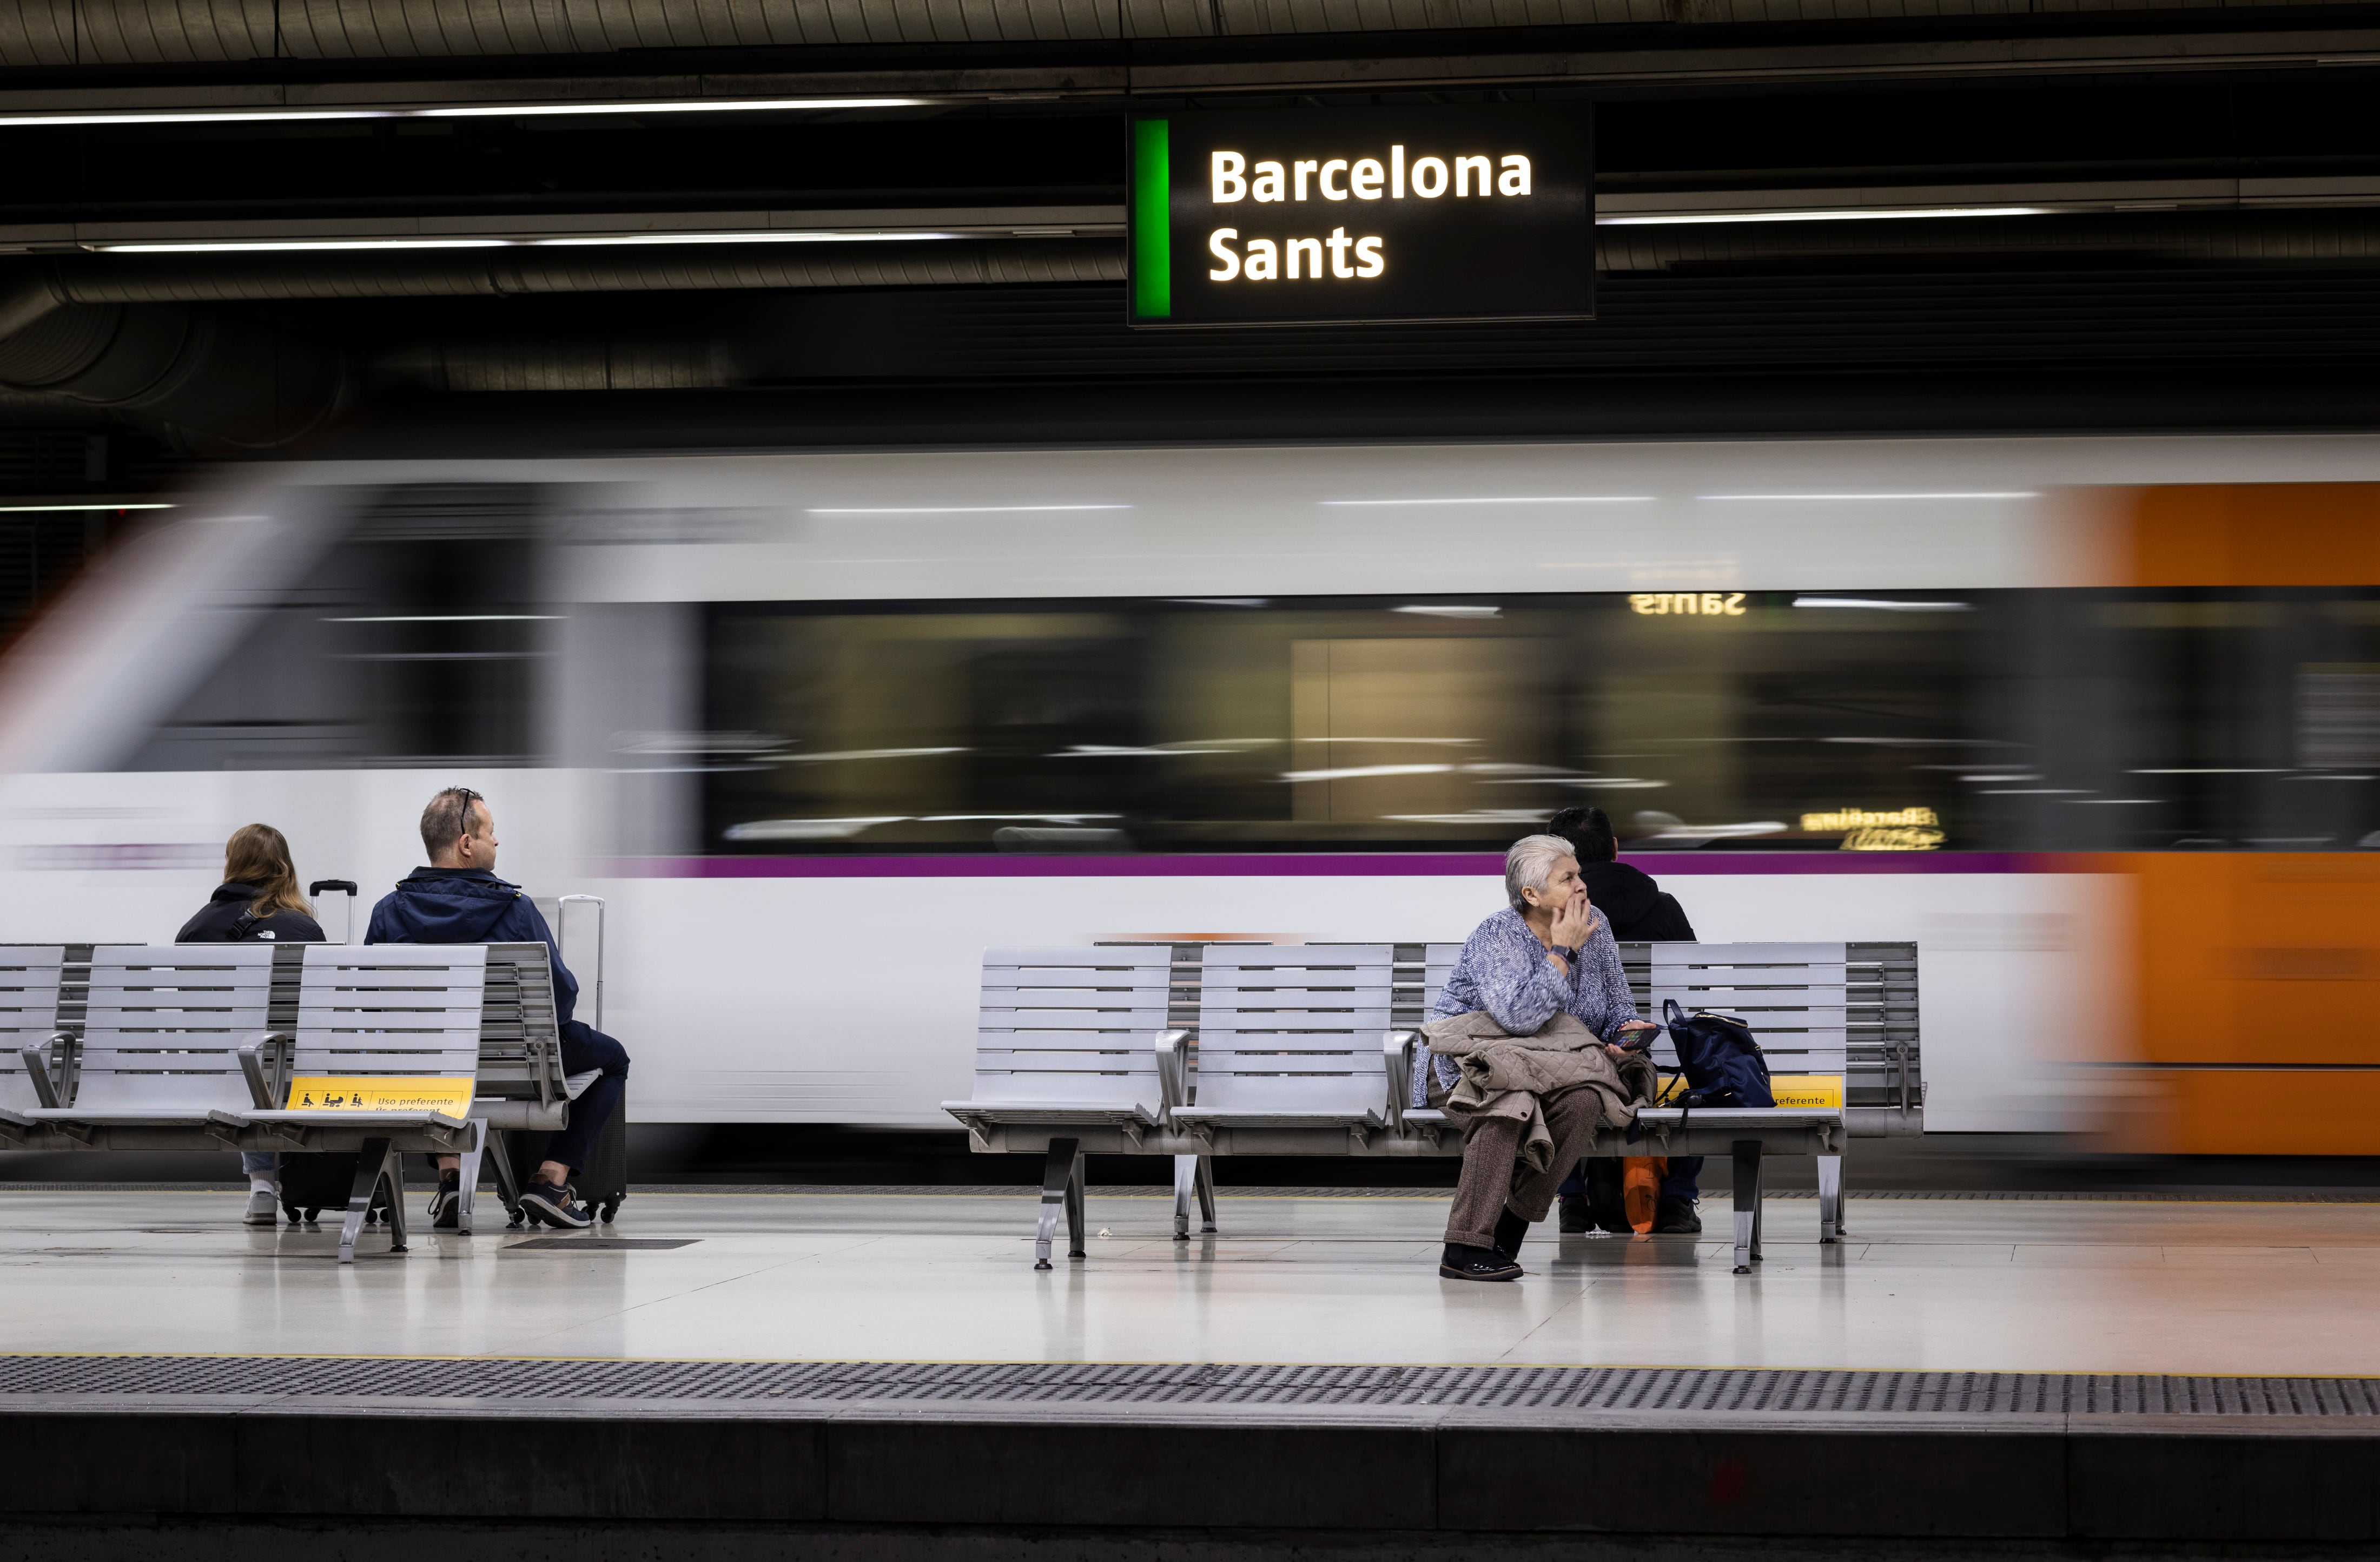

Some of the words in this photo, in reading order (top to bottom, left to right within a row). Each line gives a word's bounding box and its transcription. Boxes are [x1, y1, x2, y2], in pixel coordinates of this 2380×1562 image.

[1211, 145, 1531, 203] Barcelona
[1209, 227, 1385, 281] Sants
[399, 1097, 453, 1106] preferente
